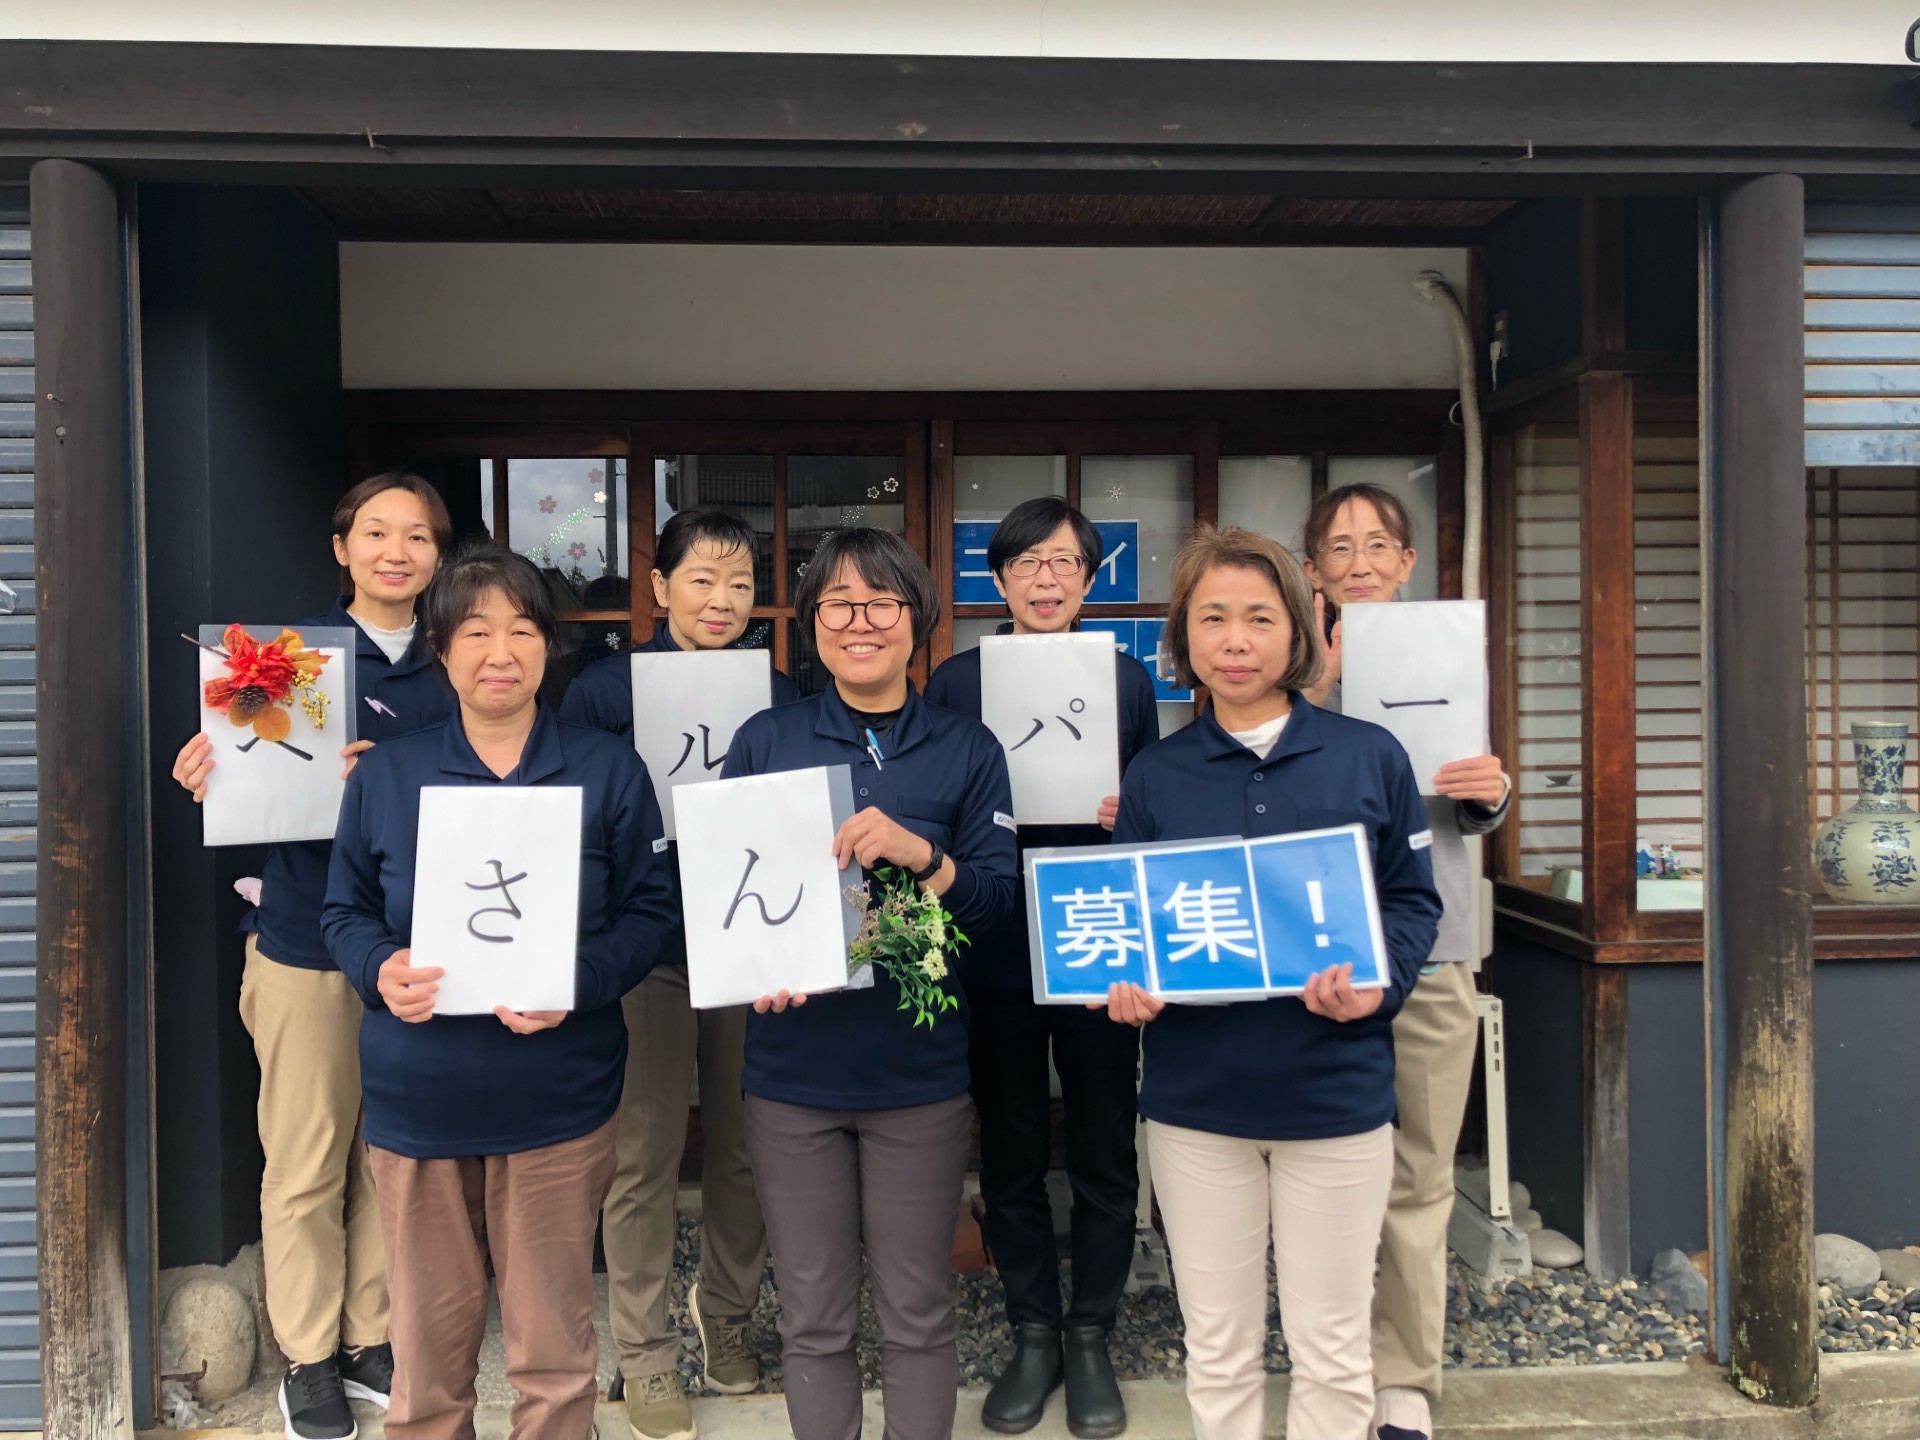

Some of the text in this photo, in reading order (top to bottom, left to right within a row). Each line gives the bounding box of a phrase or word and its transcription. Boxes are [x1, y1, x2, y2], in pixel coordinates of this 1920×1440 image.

[667, 723, 728, 777] ル
[1010, 698, 1086, 752] パ
[465, 860, 527, 943] さ
[723, 848, 803, 930] ん
